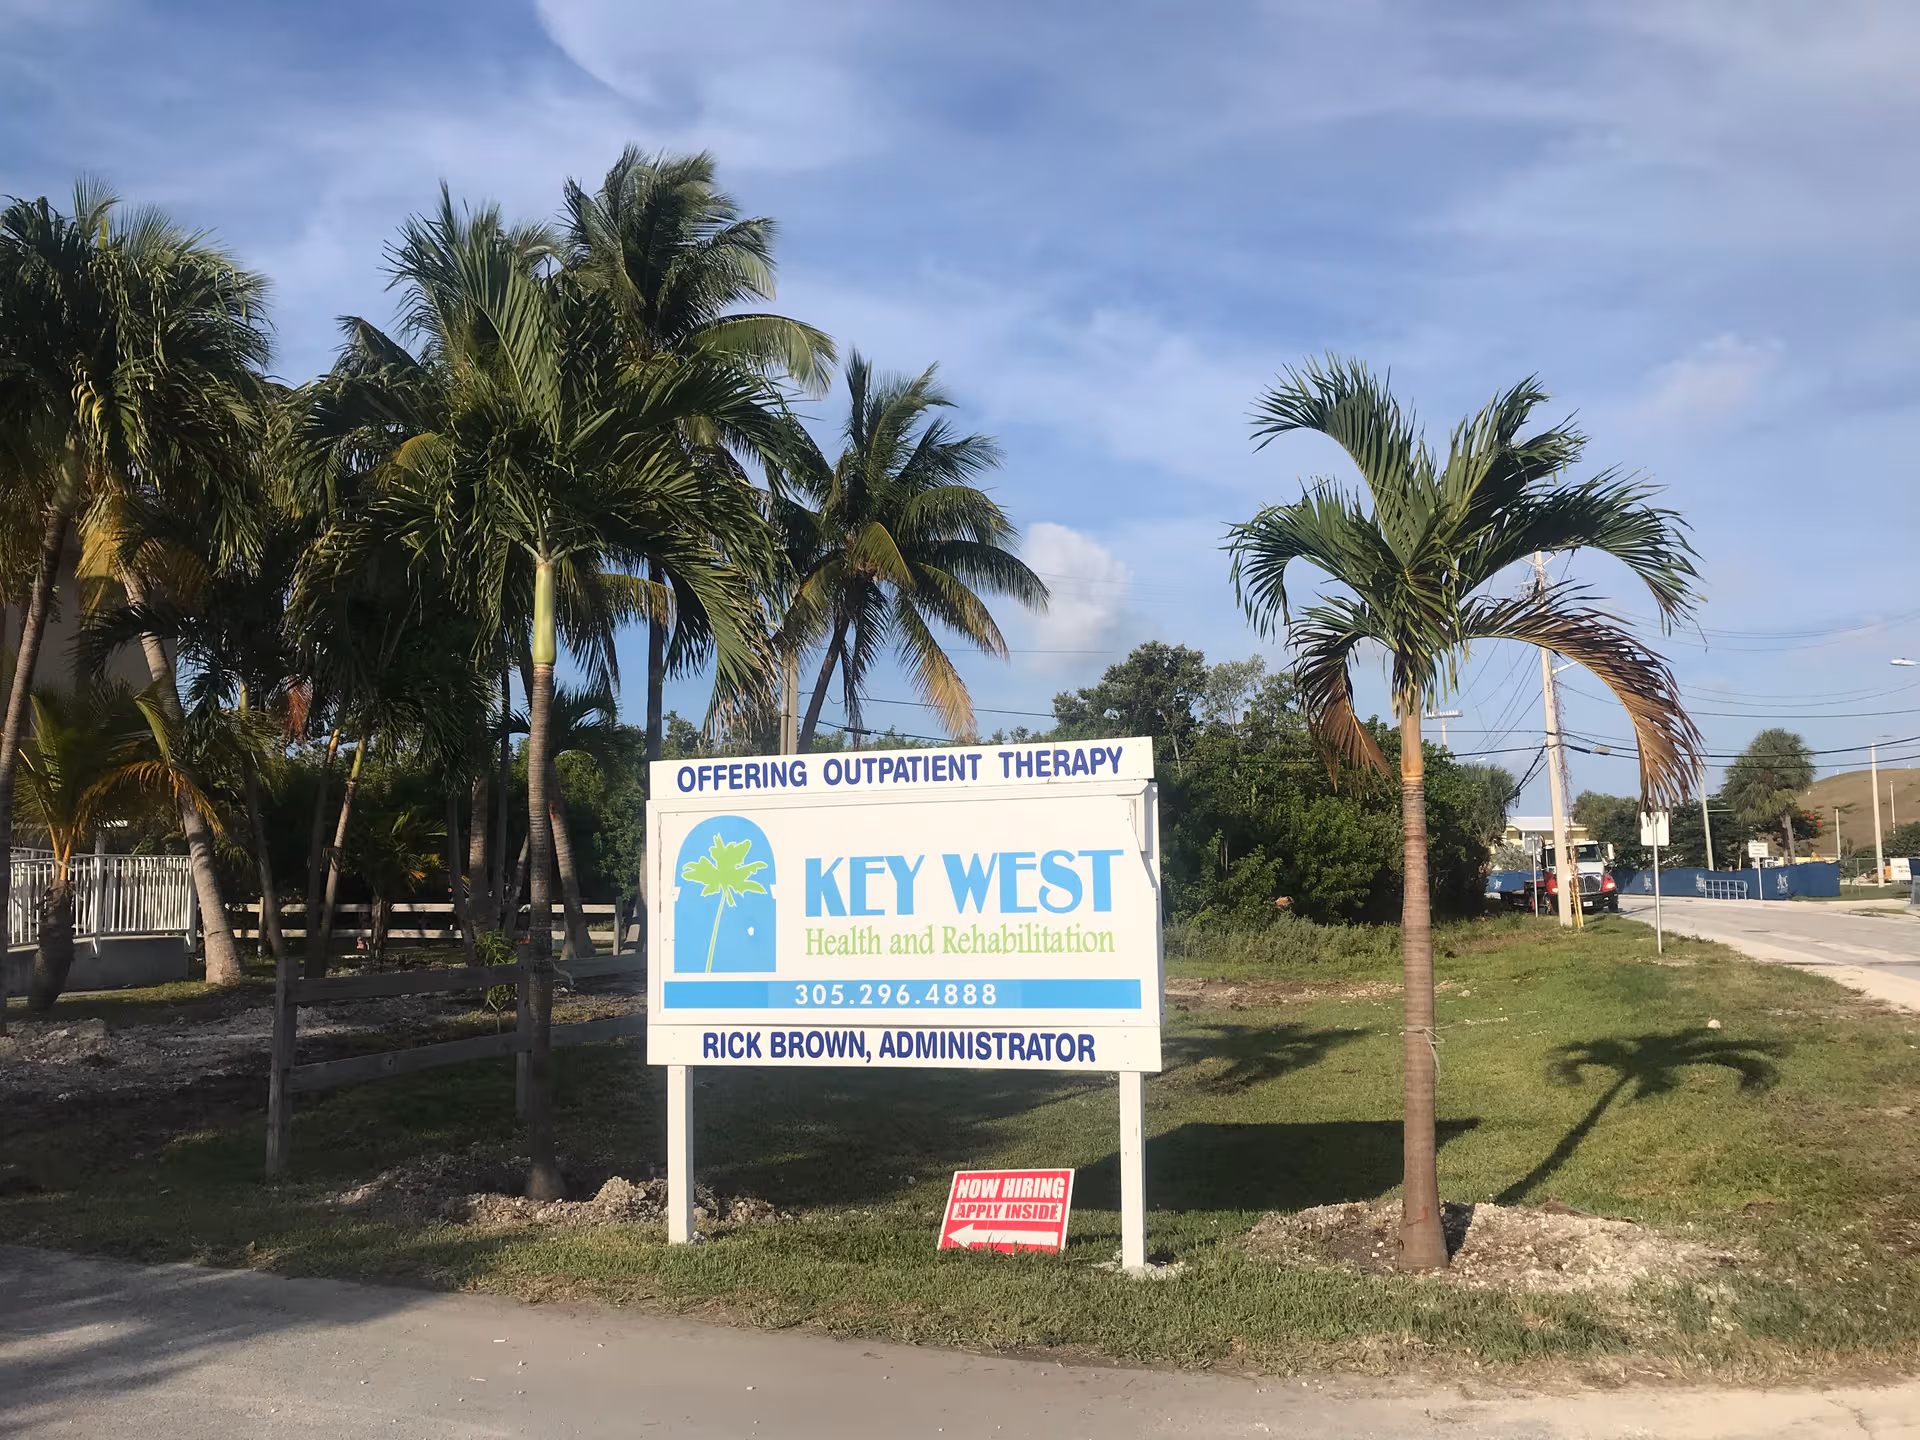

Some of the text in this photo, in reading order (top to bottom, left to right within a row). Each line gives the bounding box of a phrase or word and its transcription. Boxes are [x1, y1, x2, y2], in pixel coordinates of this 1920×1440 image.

[676, 746, 1123, 793] OFFERING OUTPATIENT THERAPY
[805, 849, 1124, 918] KEY WEST
[805, 922, 1116, 956] Health and Rehabilitation
[794, 983, 998, 1006] 305.296.4888
[703, 1030, 1096, 1063] RICK BROWN, ADMINISTRATOR
[956, 1177, 1066, 1199] NOW HIRING
[955, 1203, 1060, 1220] APPLY INSIDE
